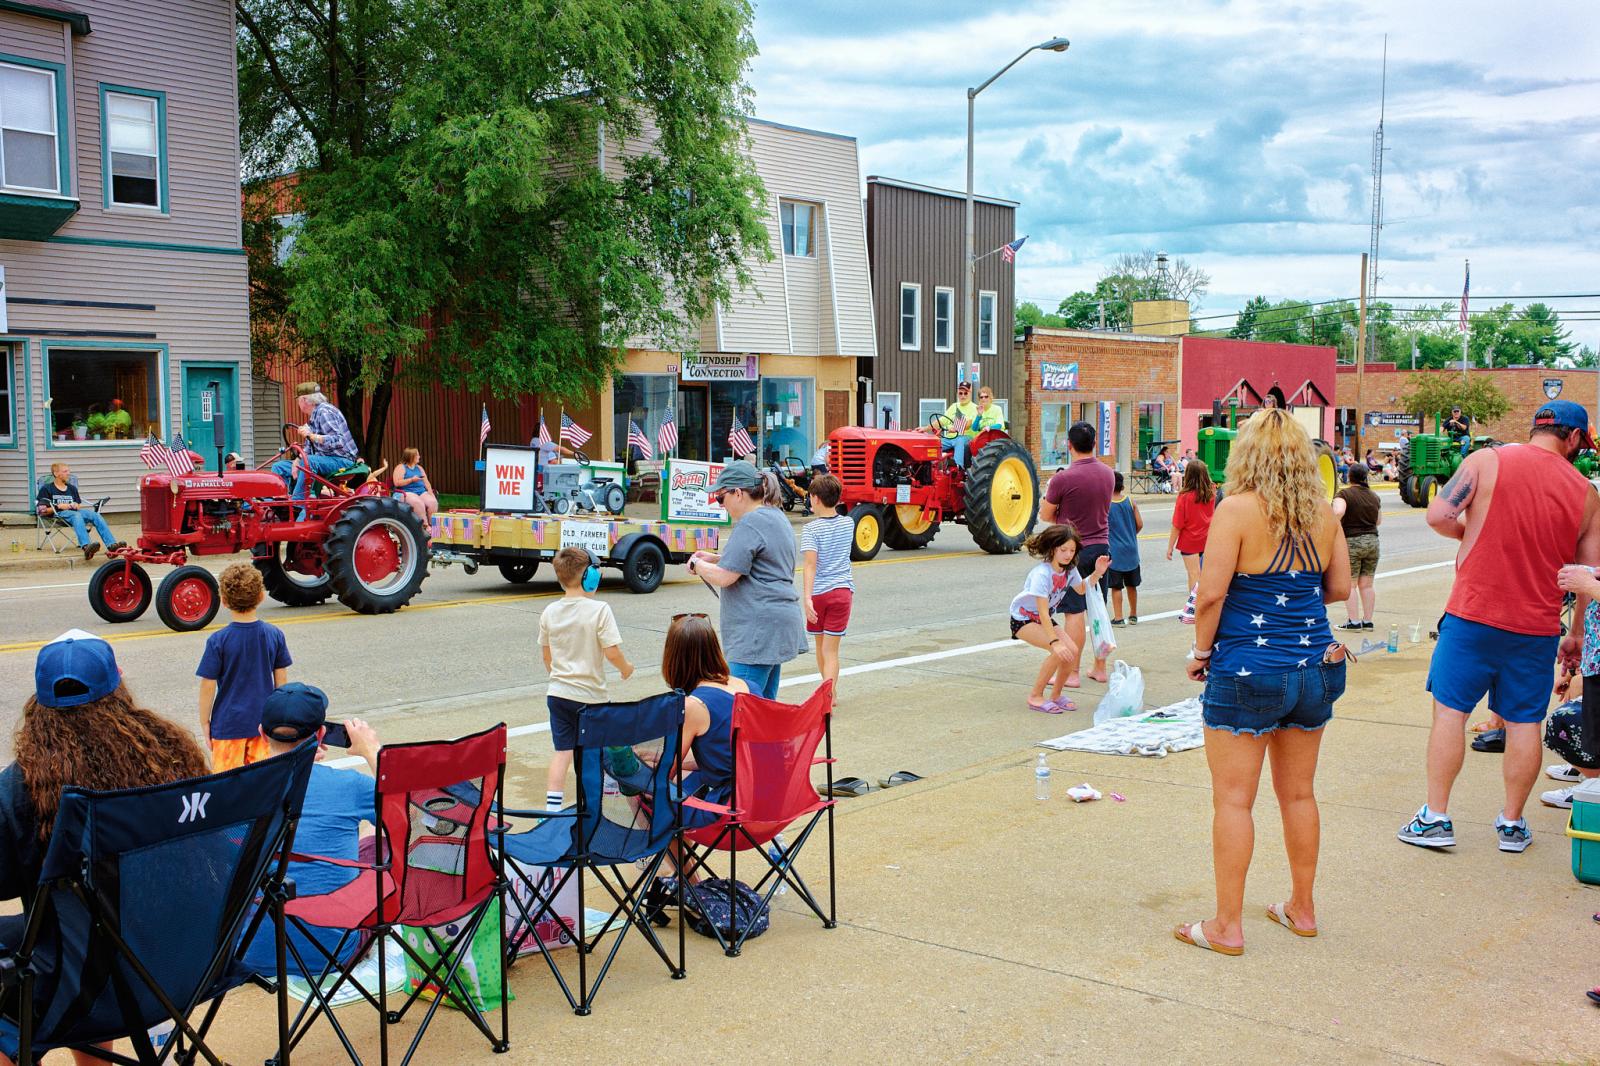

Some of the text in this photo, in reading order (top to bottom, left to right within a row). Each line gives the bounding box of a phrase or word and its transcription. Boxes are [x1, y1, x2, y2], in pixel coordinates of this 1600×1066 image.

[686, 355, 741, 369] FRIENDSHIP
[690, 365, 745, 378] CONNECTION
[1042, 372, 1074, 388] FISH
[495, 464, 525, 480] WIN
[673, 474, 703, 488] Raffle
[499, 481, 521, 496] ME
[580, 530, 607, 539] FARMERS
[591, 543, 607, 551] CLUB
